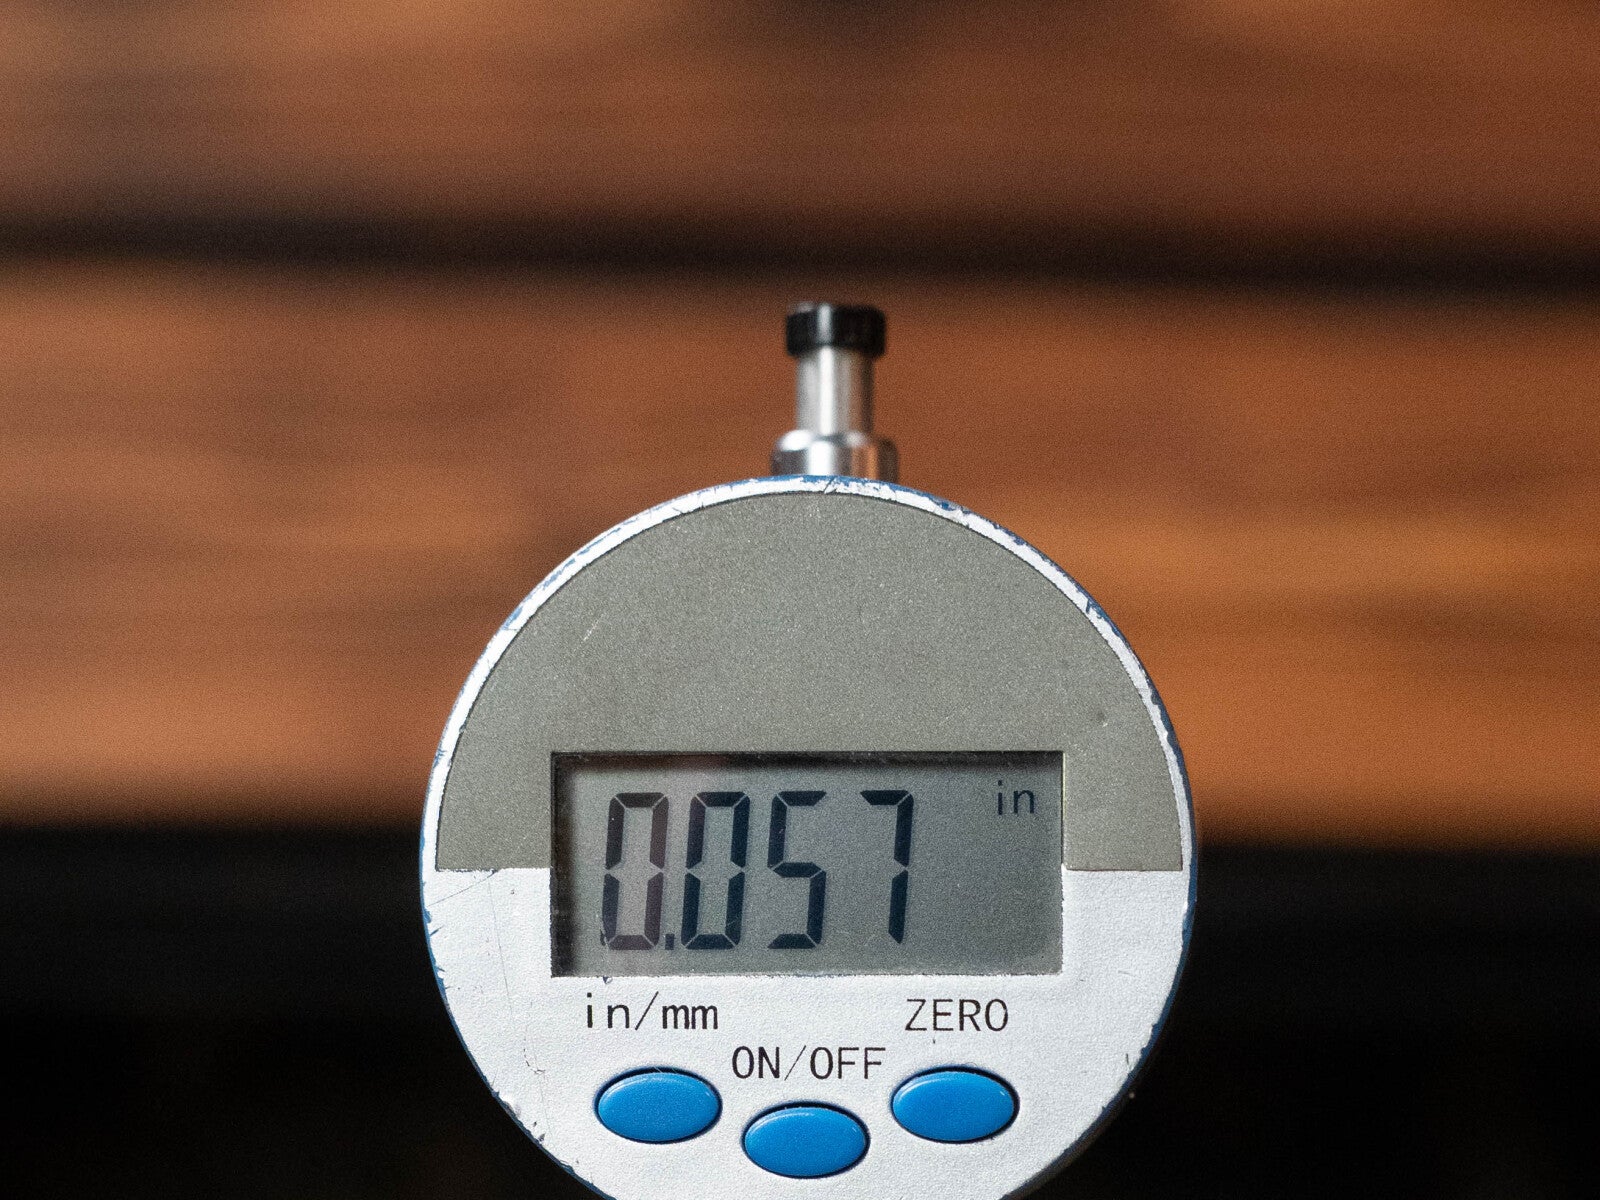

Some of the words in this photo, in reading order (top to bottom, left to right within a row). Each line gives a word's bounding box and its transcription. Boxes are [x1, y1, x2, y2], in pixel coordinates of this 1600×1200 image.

[602, 789, 914, 952] 0.057
[996, 780, 1036, 815] in
[584, 990, 719, 1034] in/mm
[904, 998, 1009, 1033] ZERO
[731, 1044, 887, 1081] ON/OFF
